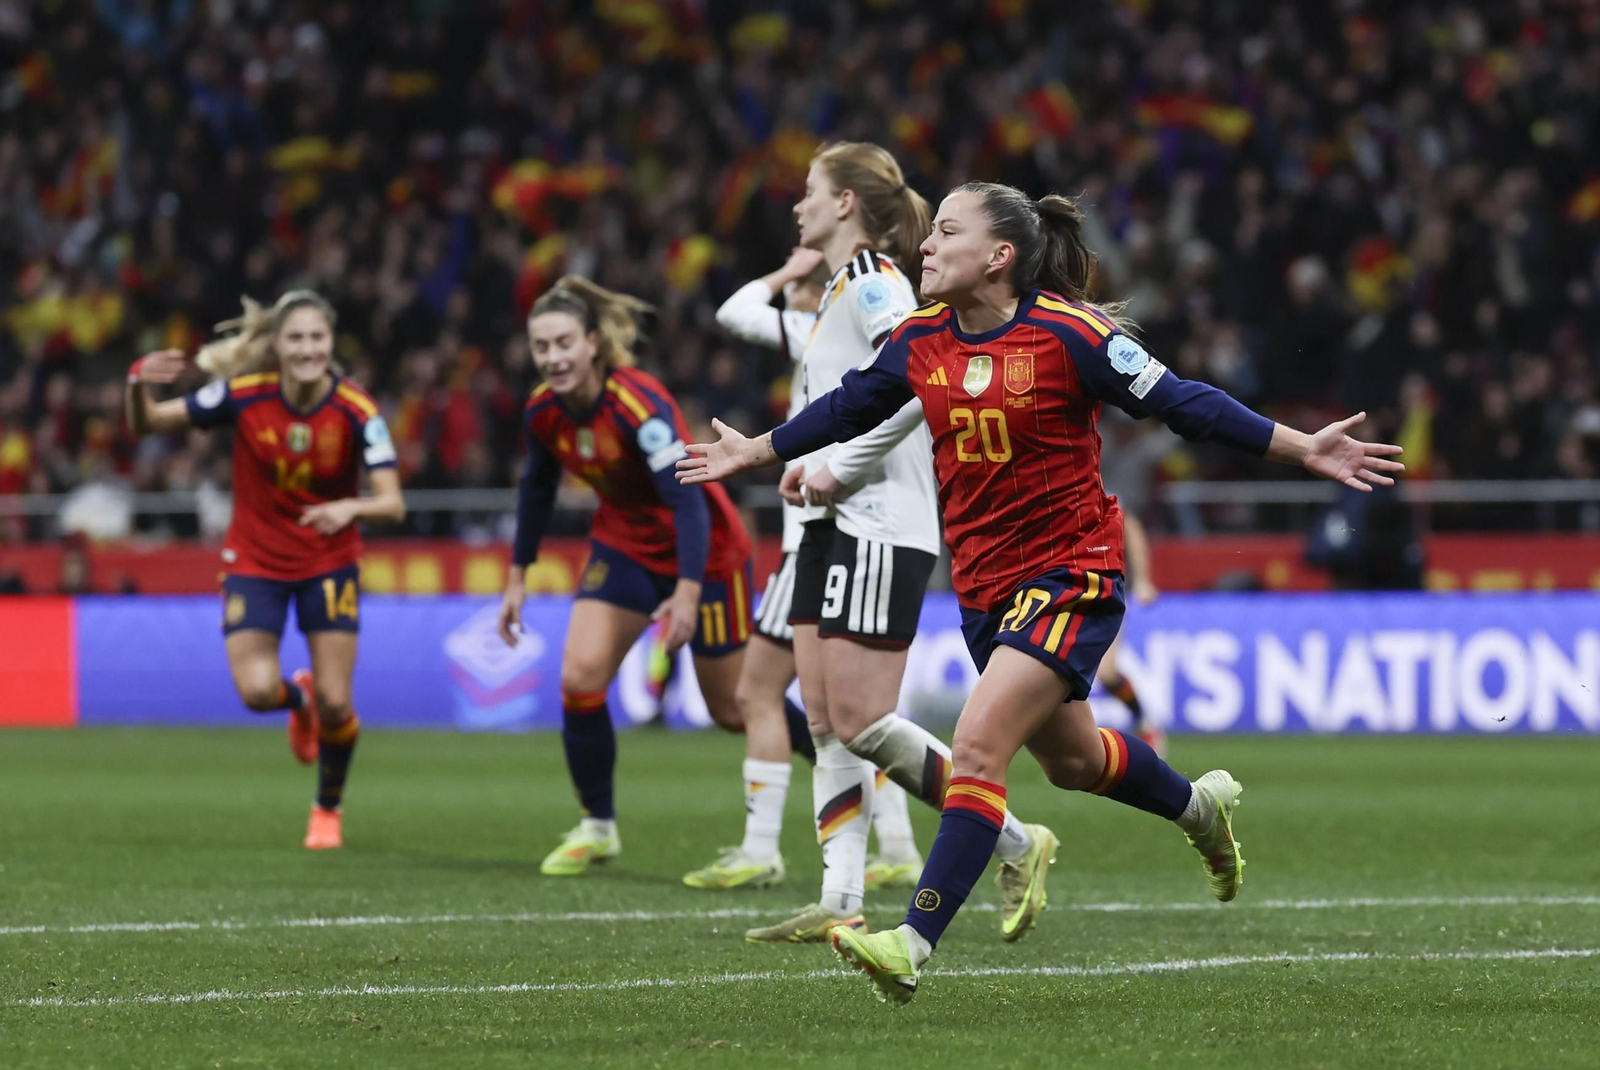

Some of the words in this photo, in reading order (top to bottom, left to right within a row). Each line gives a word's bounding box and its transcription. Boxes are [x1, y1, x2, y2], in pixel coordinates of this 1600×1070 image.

[950, 408, 1012, 462] 20
[322, 578, 358, 620] 14
[821, 564, 848, 618] 9
[999, 588, 1051, 633] 20
[701, 601, 728, 646] 11
